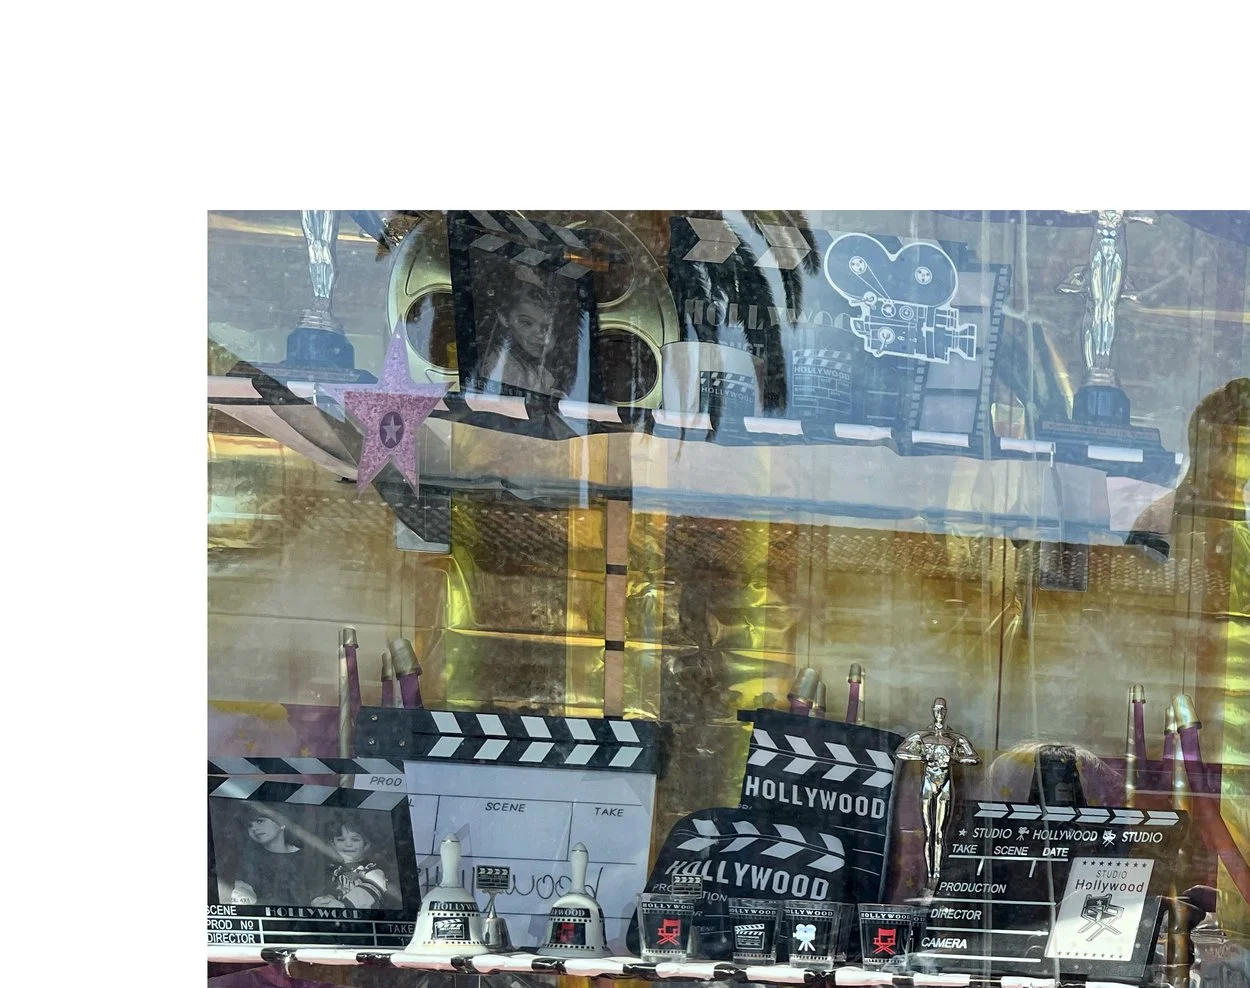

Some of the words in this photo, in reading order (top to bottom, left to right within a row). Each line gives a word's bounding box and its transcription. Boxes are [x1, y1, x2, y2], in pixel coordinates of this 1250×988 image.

[794, 366, 850, 380] HOLLYWOOD
[370, 776, 402, 787] PROD
[745, 775, 886, 819] HOLLYWOOD
[485, 802, 525, 812] SCENE
[594, 807, 624, 817] TAKE
[972, 828, 1012, 839] STUDIO
[1032, 829, 1098, 842] HOLLYWOOD
[1122, 831, 1163, 843] STUDIO
[952, 844, 977, 854] TAKE
[993, 846, 1029, 856] SCENE
[1042, 847, 1069, 858] DATE
[665, 859, 829, 900] HOLLYWOOD
[1095, 869, 1128, 880] STUDIO
[653, 883, 728, 902] PROTION
[939, 882, 1007, 894] PRODUCTION
[1075, 878, 1145, 893] Hollywood
[207, 905, 237, 916] SCENE
[265, 906, 364, 919] HOLLYWOOD
[930, 908, 982, 920] DIRECTOR
[207, 920, 232, 930] PROD
[388, 924, 414, 934] TAKE
[207, 932, 255, 944] DIRECTOR
[920, 937, 968, 949] CAMERA
